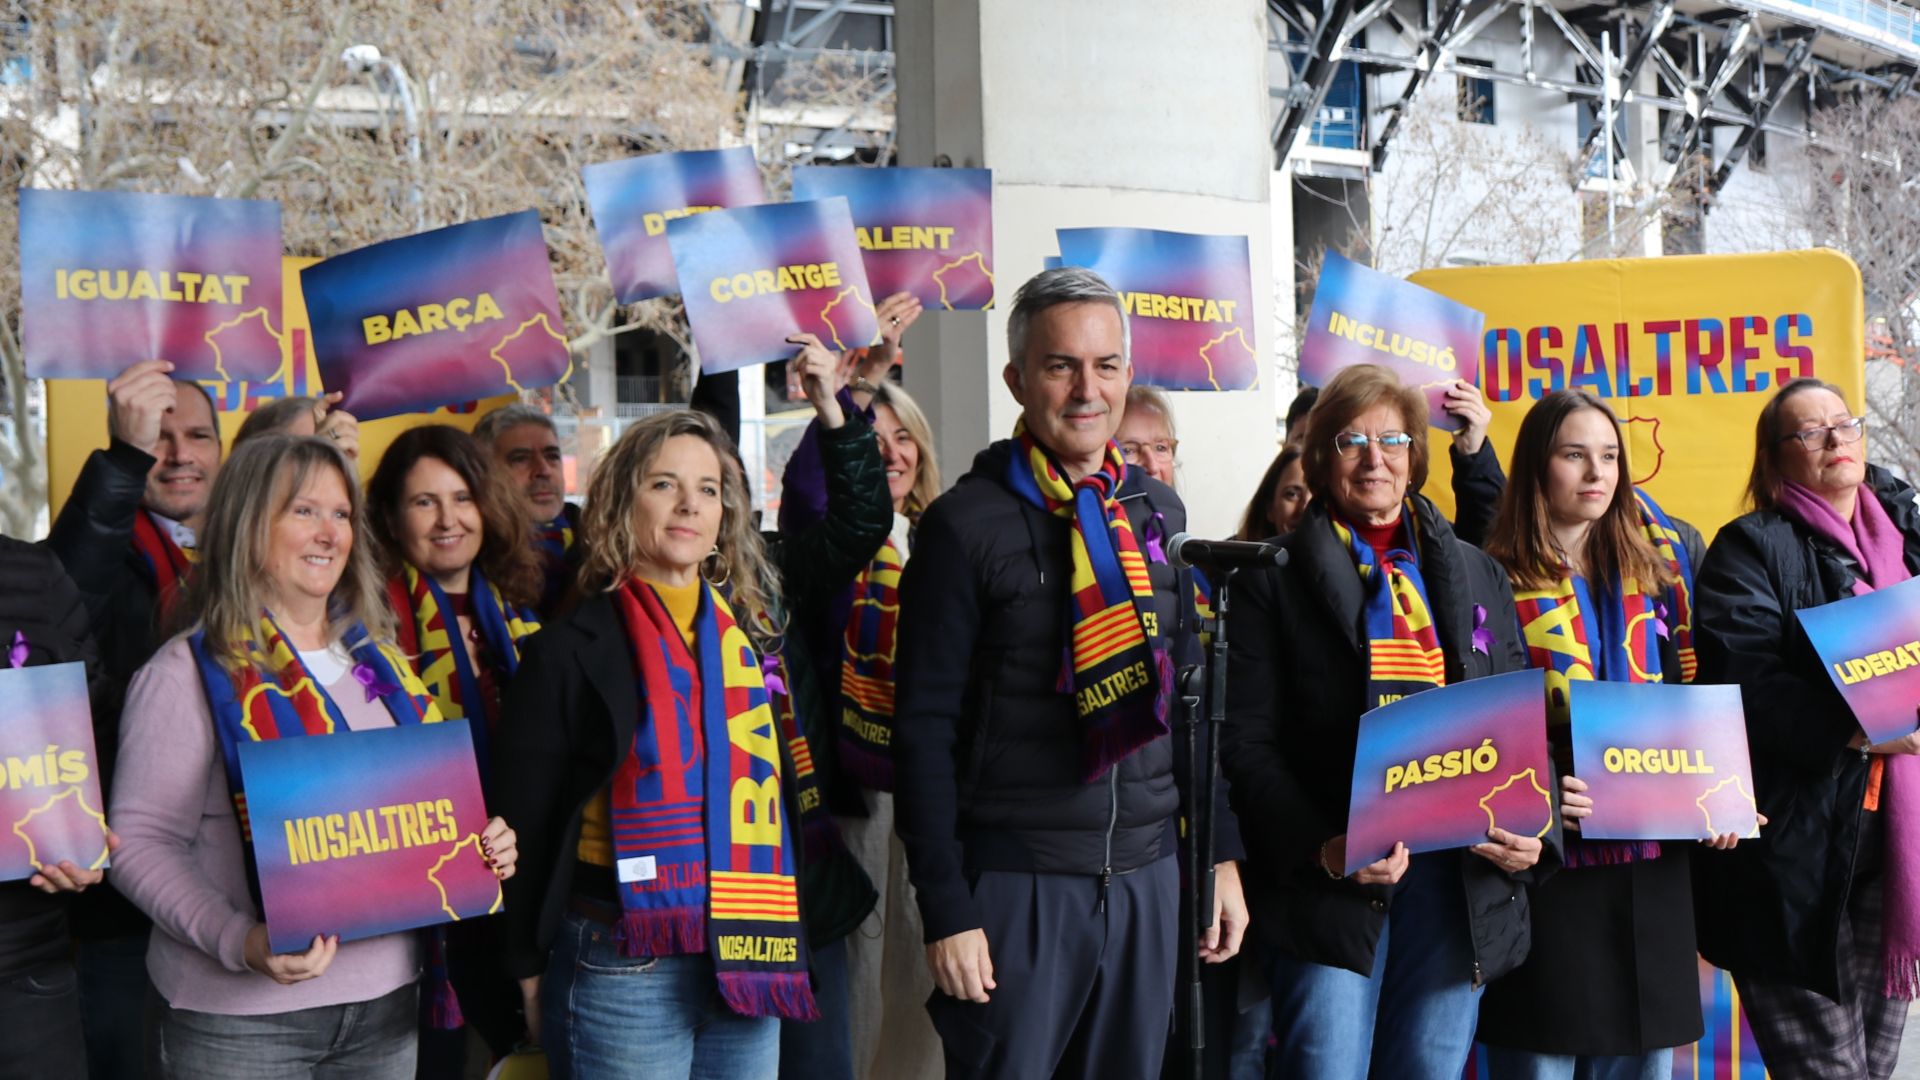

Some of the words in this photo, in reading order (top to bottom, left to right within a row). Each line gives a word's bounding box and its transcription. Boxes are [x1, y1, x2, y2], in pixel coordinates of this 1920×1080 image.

[56, 269, 250, 305] IGUALTAT
[710, 262, 842, 303] CORATGE
[362, 293, 504, 346] BARÇA
[1328, 311, 1457, 372] INCLUSIÓ
[1475, 313, 1815, 402] OSALTRES
[0, 744, 89, 790] MÍS
[1384, 738, 1499, 793] PASSIÓ
[1603, 747, 1714, 774] ORGULL
[284, 798, 458, 866] NOSALTRES
[717, 935, 798, 963] NOSALTRES
